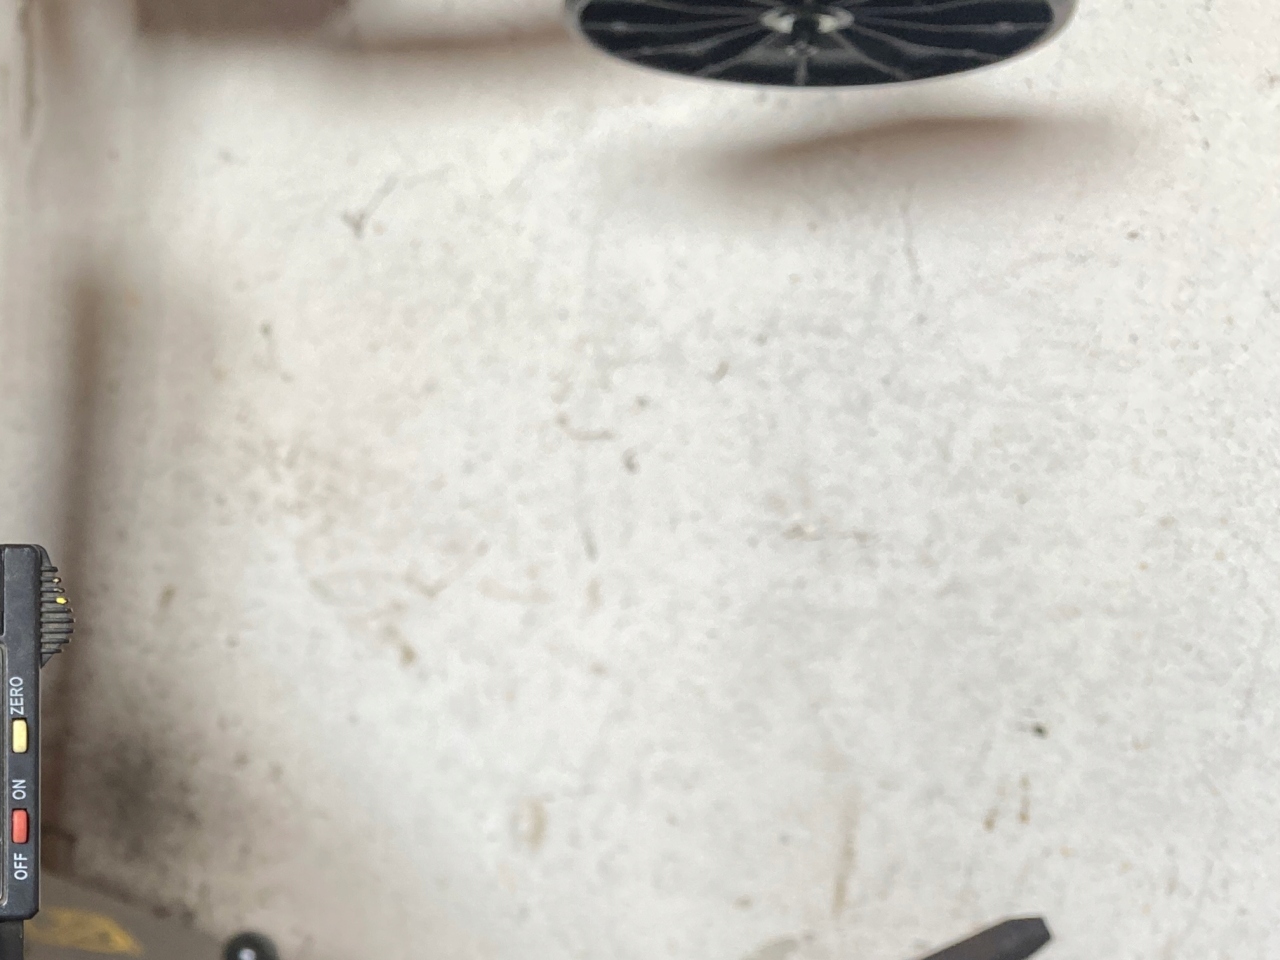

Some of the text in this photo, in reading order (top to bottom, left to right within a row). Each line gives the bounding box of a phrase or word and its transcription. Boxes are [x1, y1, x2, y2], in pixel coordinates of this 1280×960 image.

[10, 676, 24, 716] ZERO
[12, 779, 27, 800] ON
[14, 852, 28, 881] OFF
